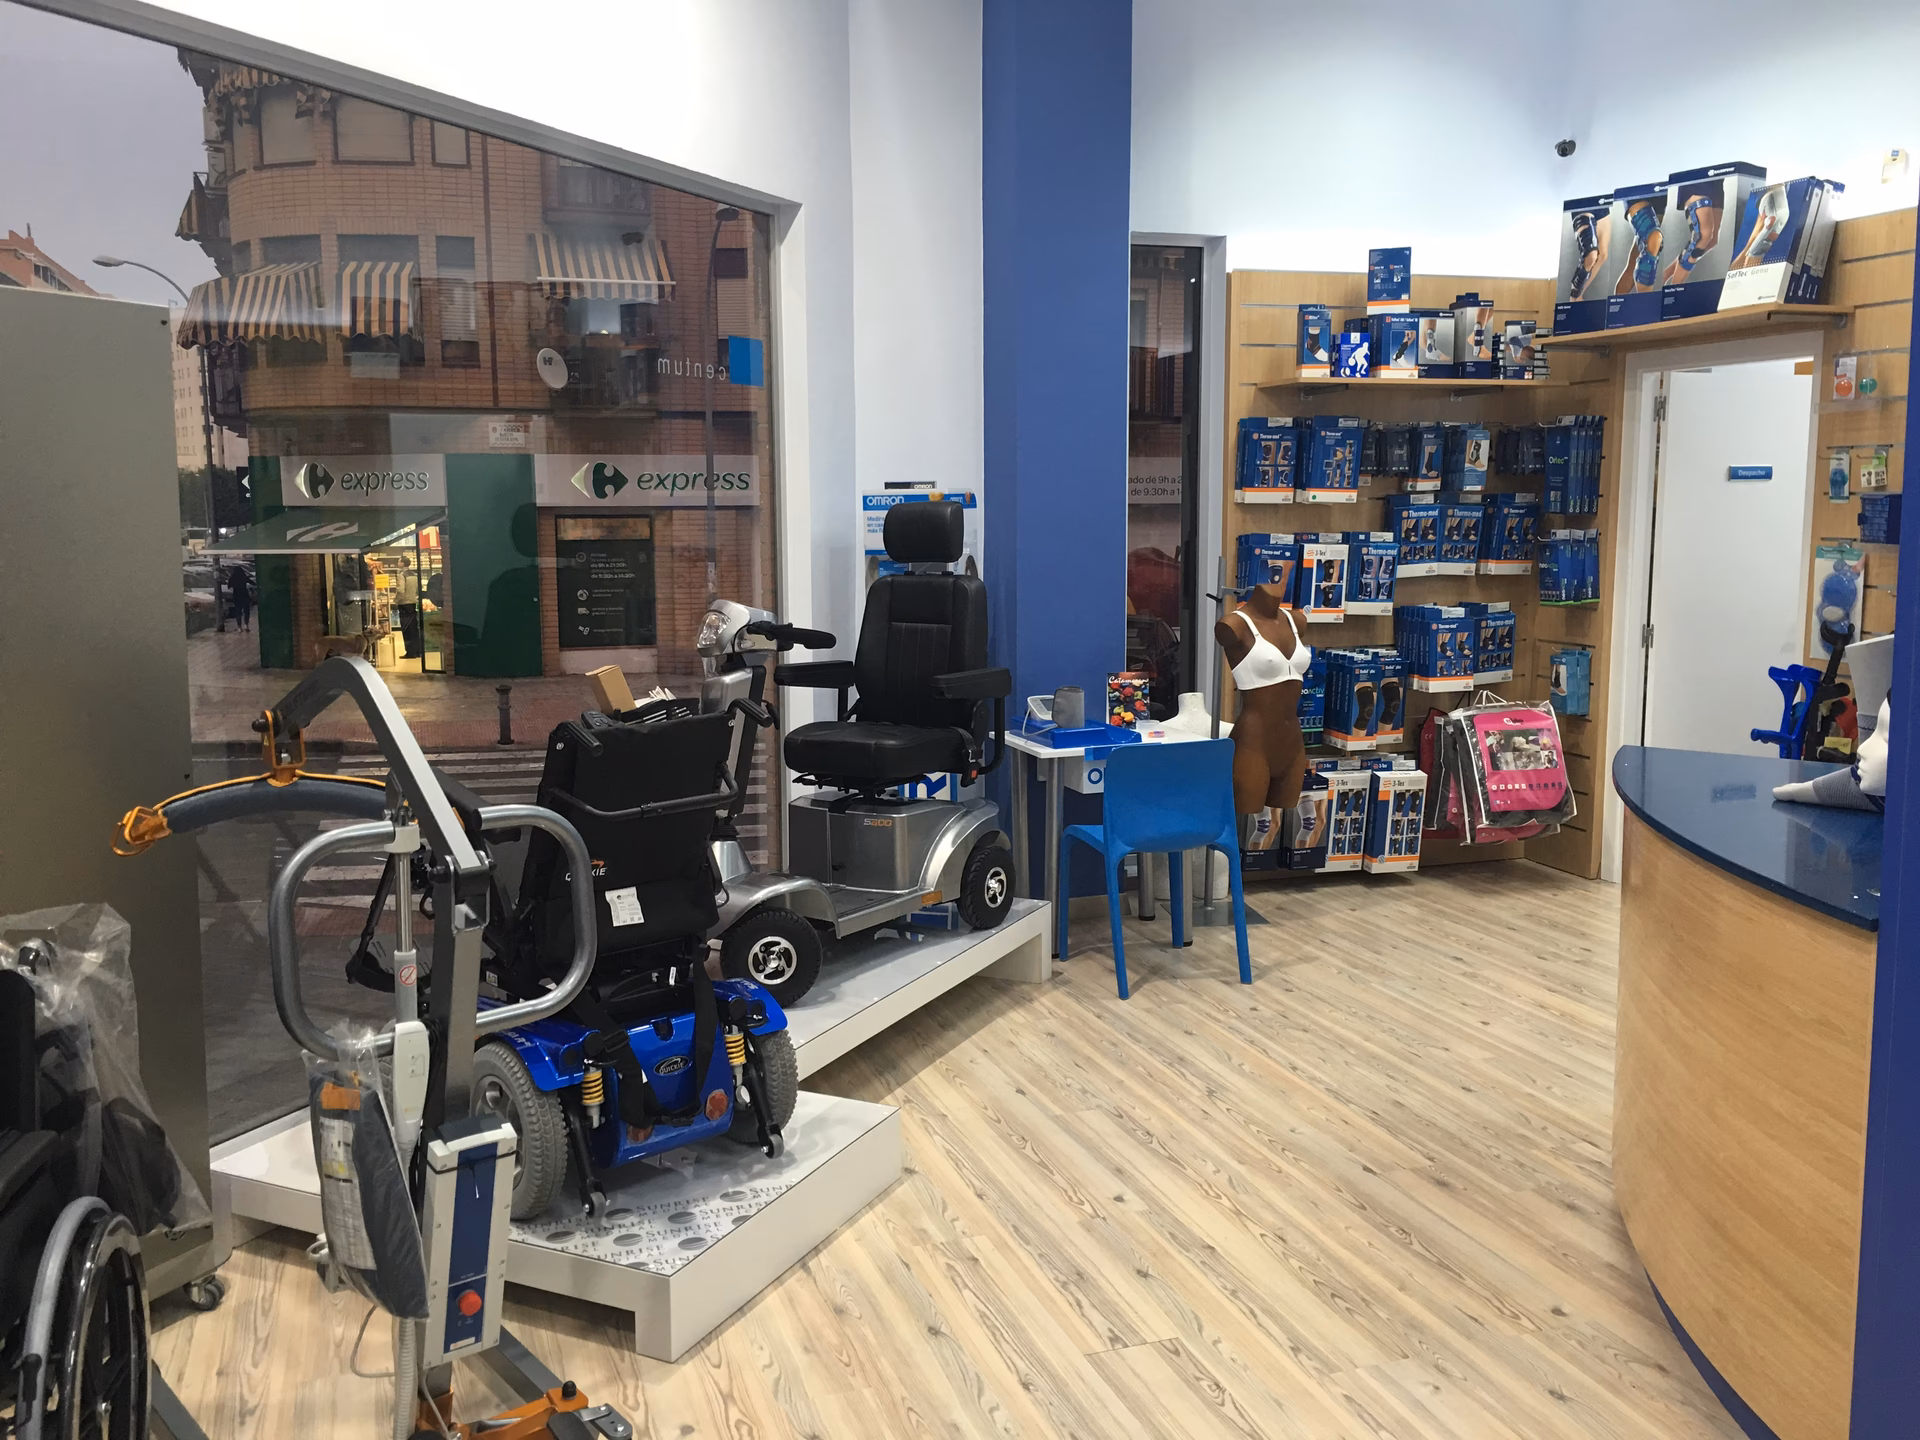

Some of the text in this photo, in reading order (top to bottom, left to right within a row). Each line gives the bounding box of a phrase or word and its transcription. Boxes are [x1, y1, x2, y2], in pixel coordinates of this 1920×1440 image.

[1738, 469, 1766, 477] Despacho
[1128, 476, 1144, 484] ado
[1145, 476, 1157, 484] de
[1158, 475, 1169, 484] 9h
[341, 471, 430, 498] express
[636, 471, 752, 498] express
[1130, 488, 1142, 496] de
[1143, 487, 1168, 496] 9:30h
[1409, 508, 1439, 518] Thermo-med
[1368, 547, 1398, 556] Thermo-med
[1336, 779, 1348, 787] 3-Tex
[863, 818, 893, 827] S400
[565, 868, 608, 881] QKIE
[646, 1222, 723, 1238] SUNRISE
[648, 1227, 723, 1243] MEDICAL
